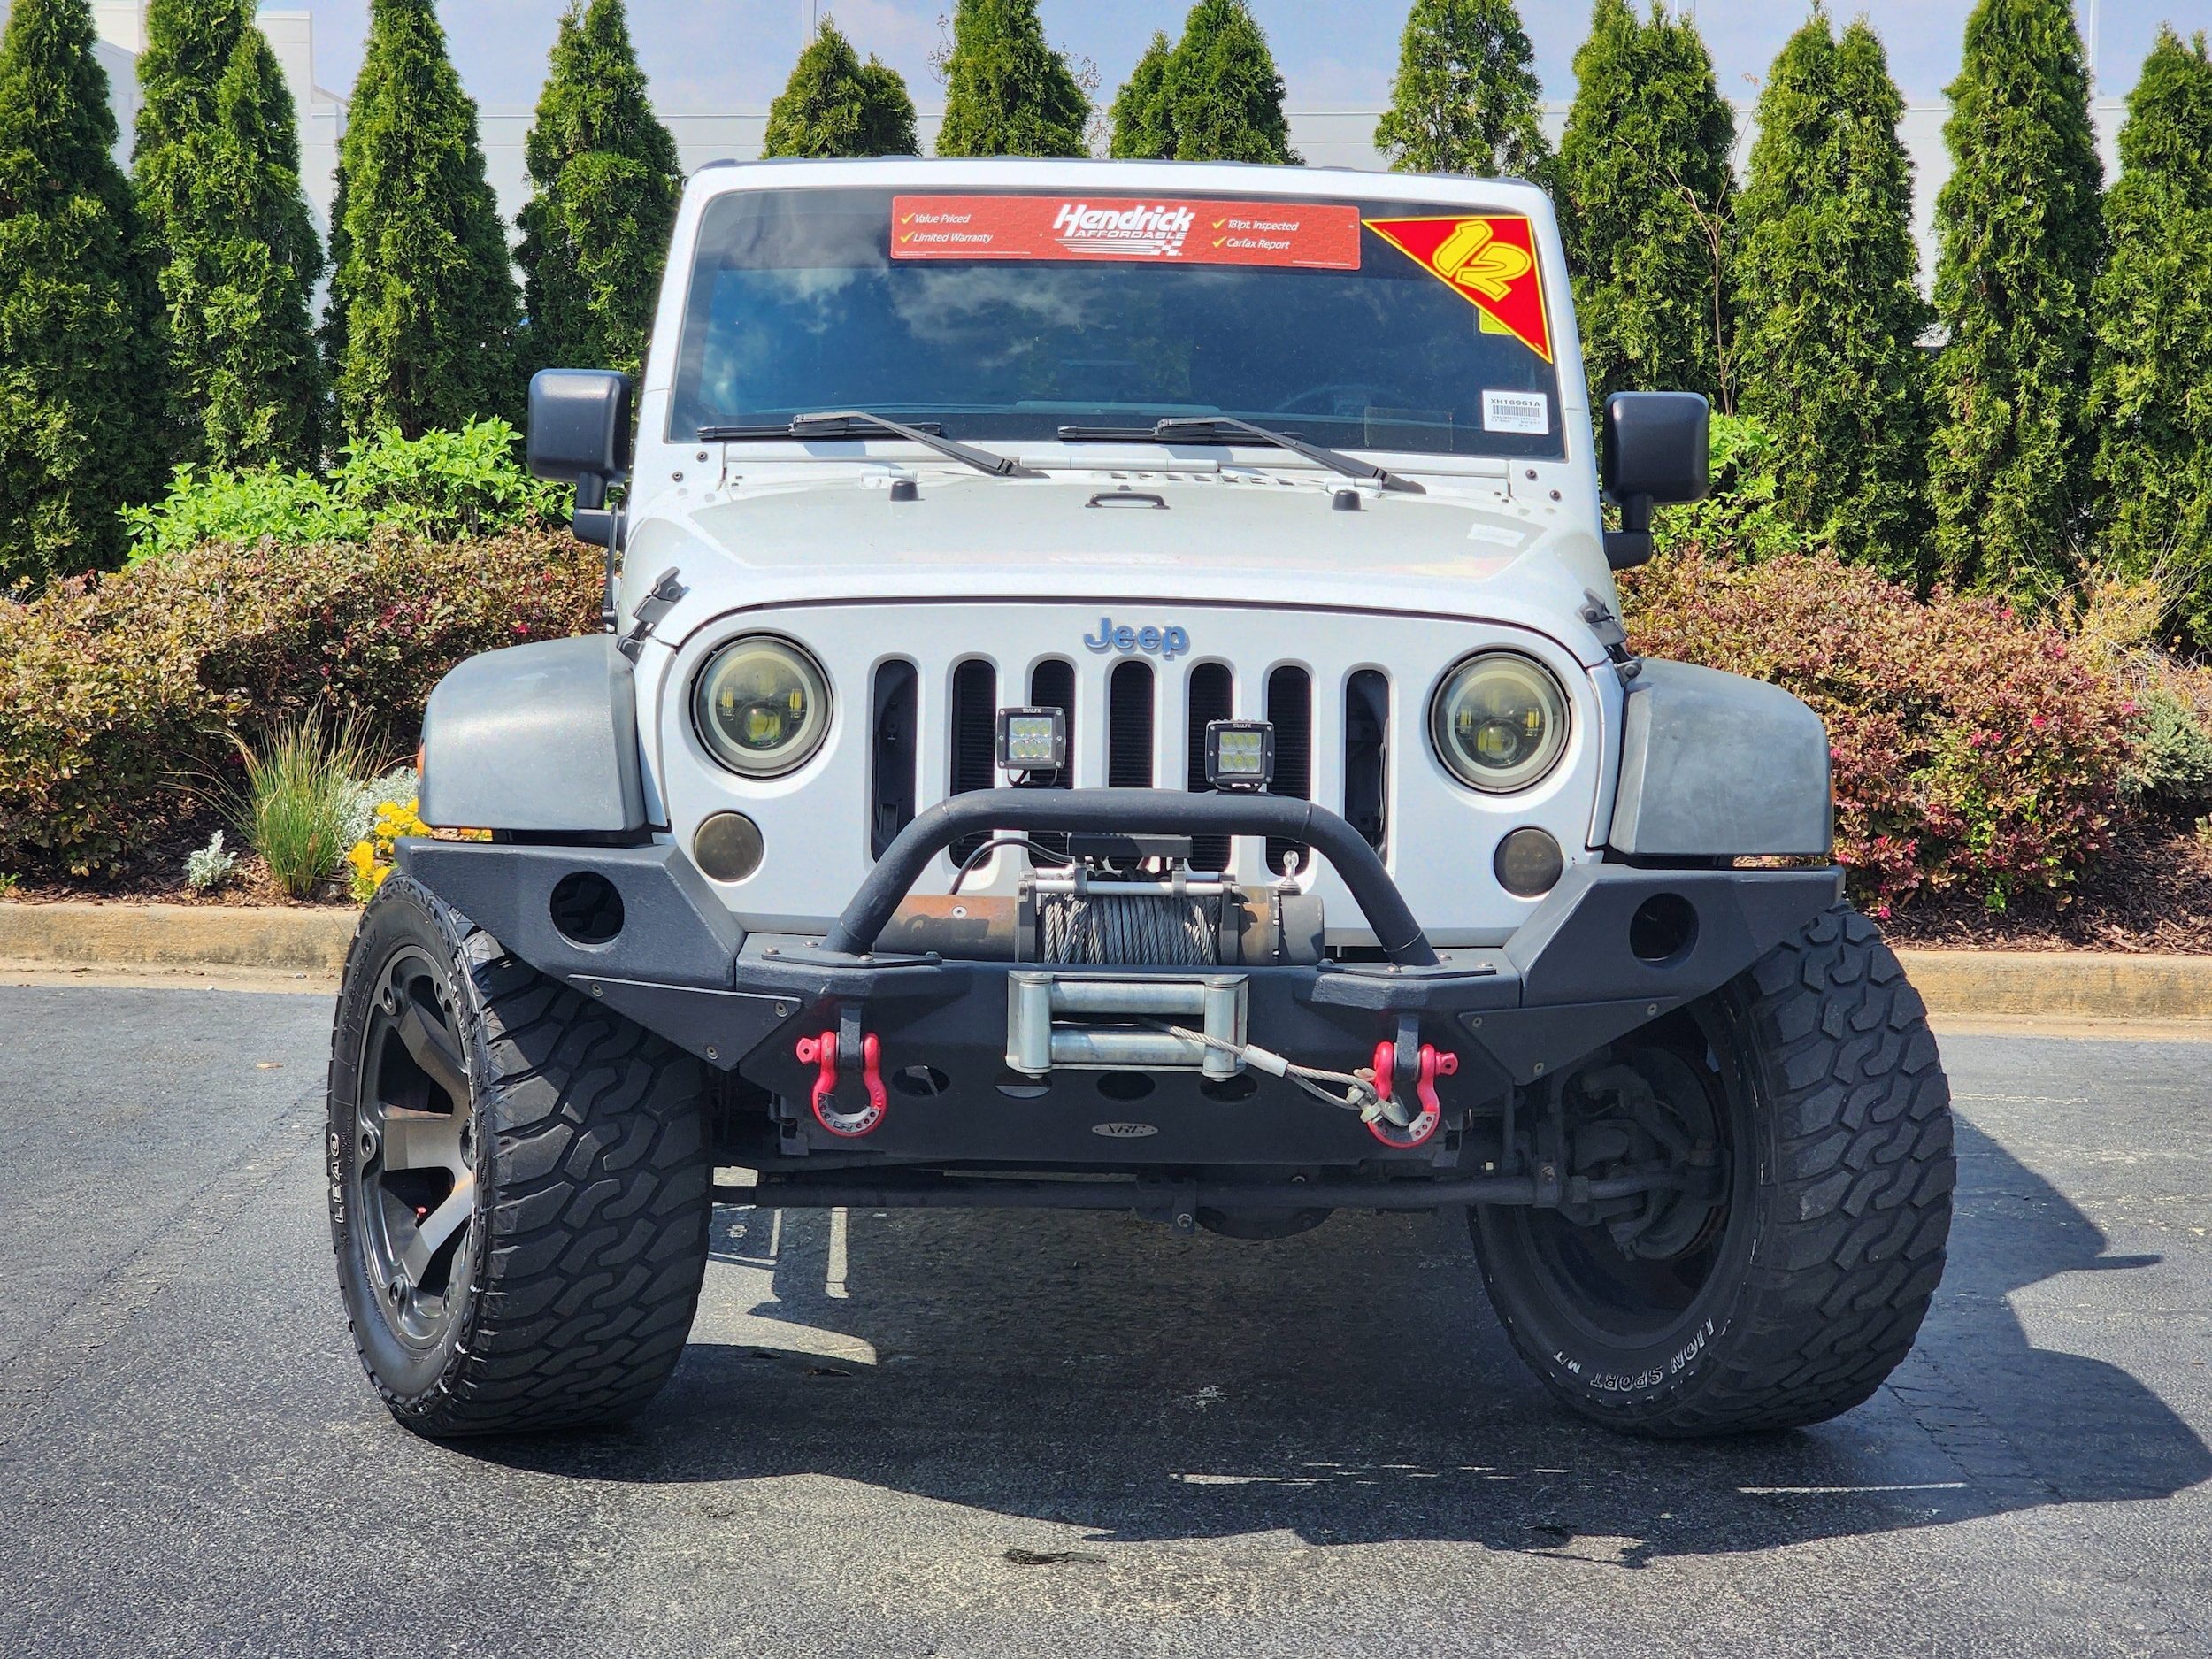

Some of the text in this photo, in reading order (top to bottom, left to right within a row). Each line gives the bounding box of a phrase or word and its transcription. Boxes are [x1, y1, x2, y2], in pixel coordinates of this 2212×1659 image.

[914, 213, 971, 224] Value Priced
[1053, 204, 1196, 237] Hendrick
[1252, 220, 1300, 232] Inspected
[913, 233, 994, 243] Limited Warranty
[1074, 230, 1187, 240] AFFORDABLE
[1226, 238, 1291, 250] Carfax Report
[1432, 219, 1532, 303] 12
[1490, 398, 1541, 407] XH16961A
[1083, 617, 1188, 657] Jeep
[1590, 1365, 1663, 1392] SPORT
